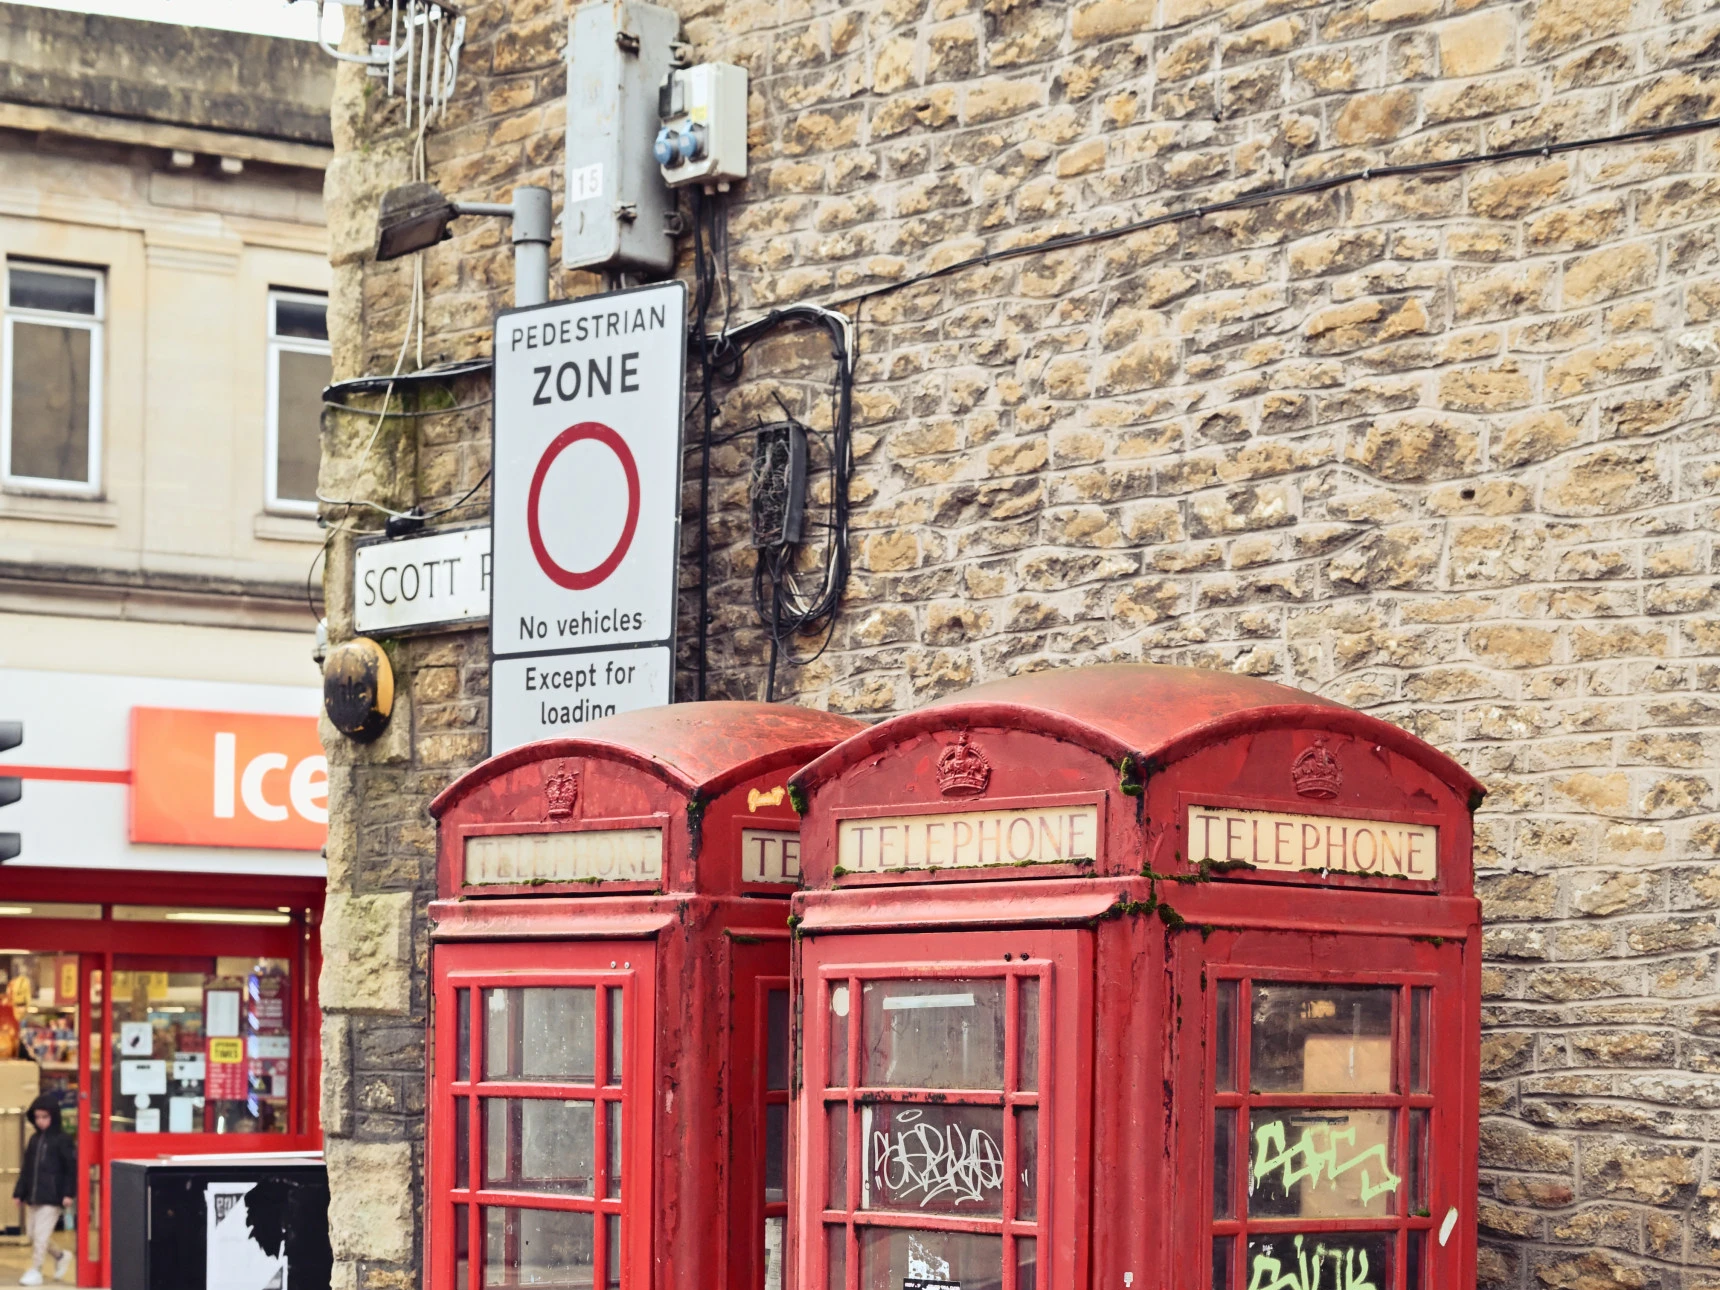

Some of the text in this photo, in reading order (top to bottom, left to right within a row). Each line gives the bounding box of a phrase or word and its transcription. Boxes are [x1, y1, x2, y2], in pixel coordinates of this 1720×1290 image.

[577, 168, 599, 197] 15
[511, 304, 666, 352] PEDESTRIAN
[532, 351, 640, 406] ZONE
[364, 556, 462, 607] SCOTT
[519, 607, 643, 641] No vehicles
[525, 660, 636, 692] Except for
[213, 731, 329, 825] Ice
[476, 835, 656, 879] TELEPHONE
[851, 813, 1089, 868] TELEPHONE
[1195, 814, 1425, 875] TELEPHONE
